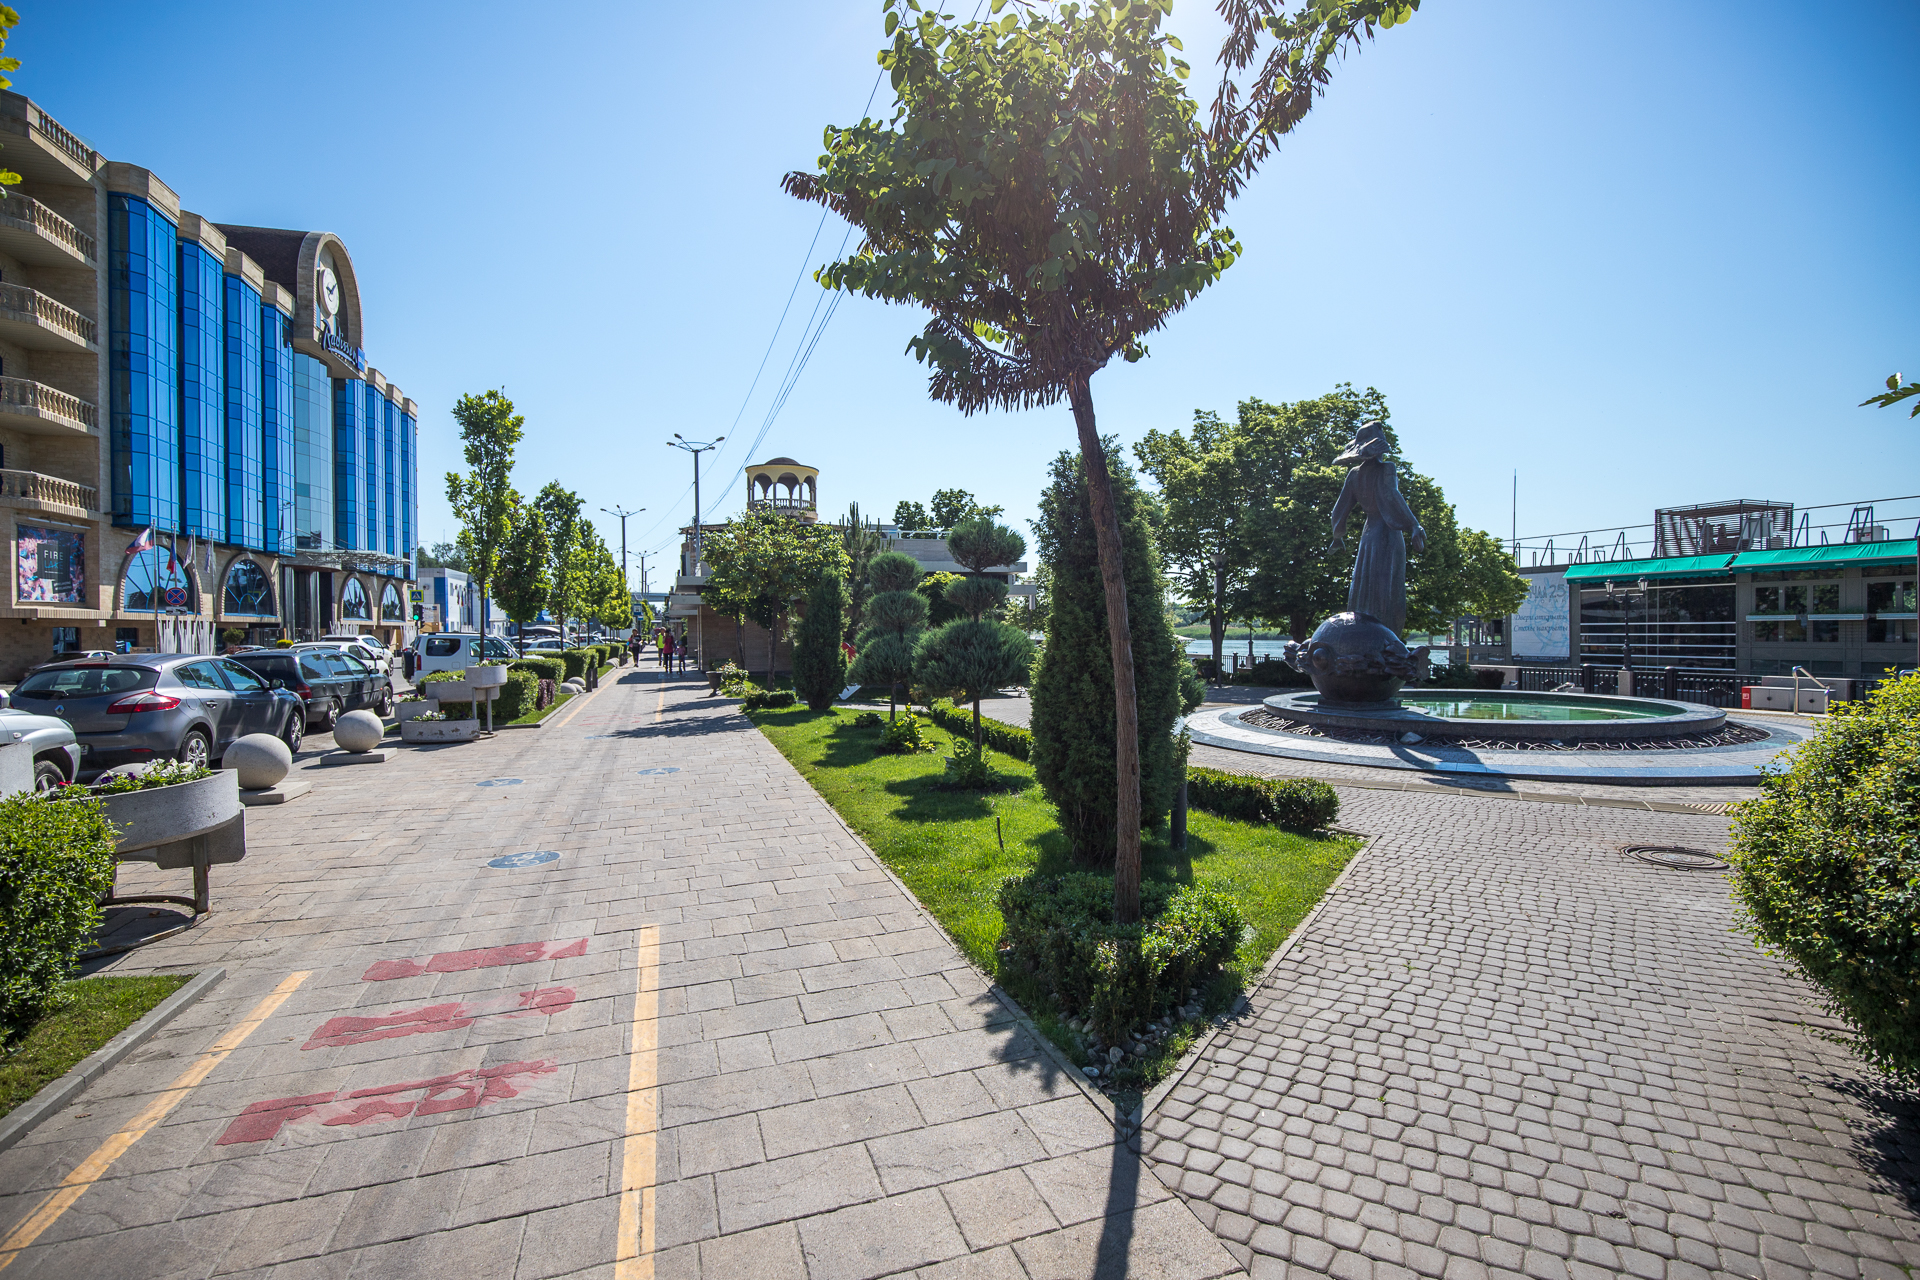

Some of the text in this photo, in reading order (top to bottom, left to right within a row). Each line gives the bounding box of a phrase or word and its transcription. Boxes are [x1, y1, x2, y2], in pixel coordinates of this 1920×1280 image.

[44, 550, 64, 560] FIRE
[44, 561, 64, 569] LAKE
[1549, 584, 1566, 599] 25
[1515, 614, 1534, 622] Двери
[1513, 624, 1535, 632] Столы
